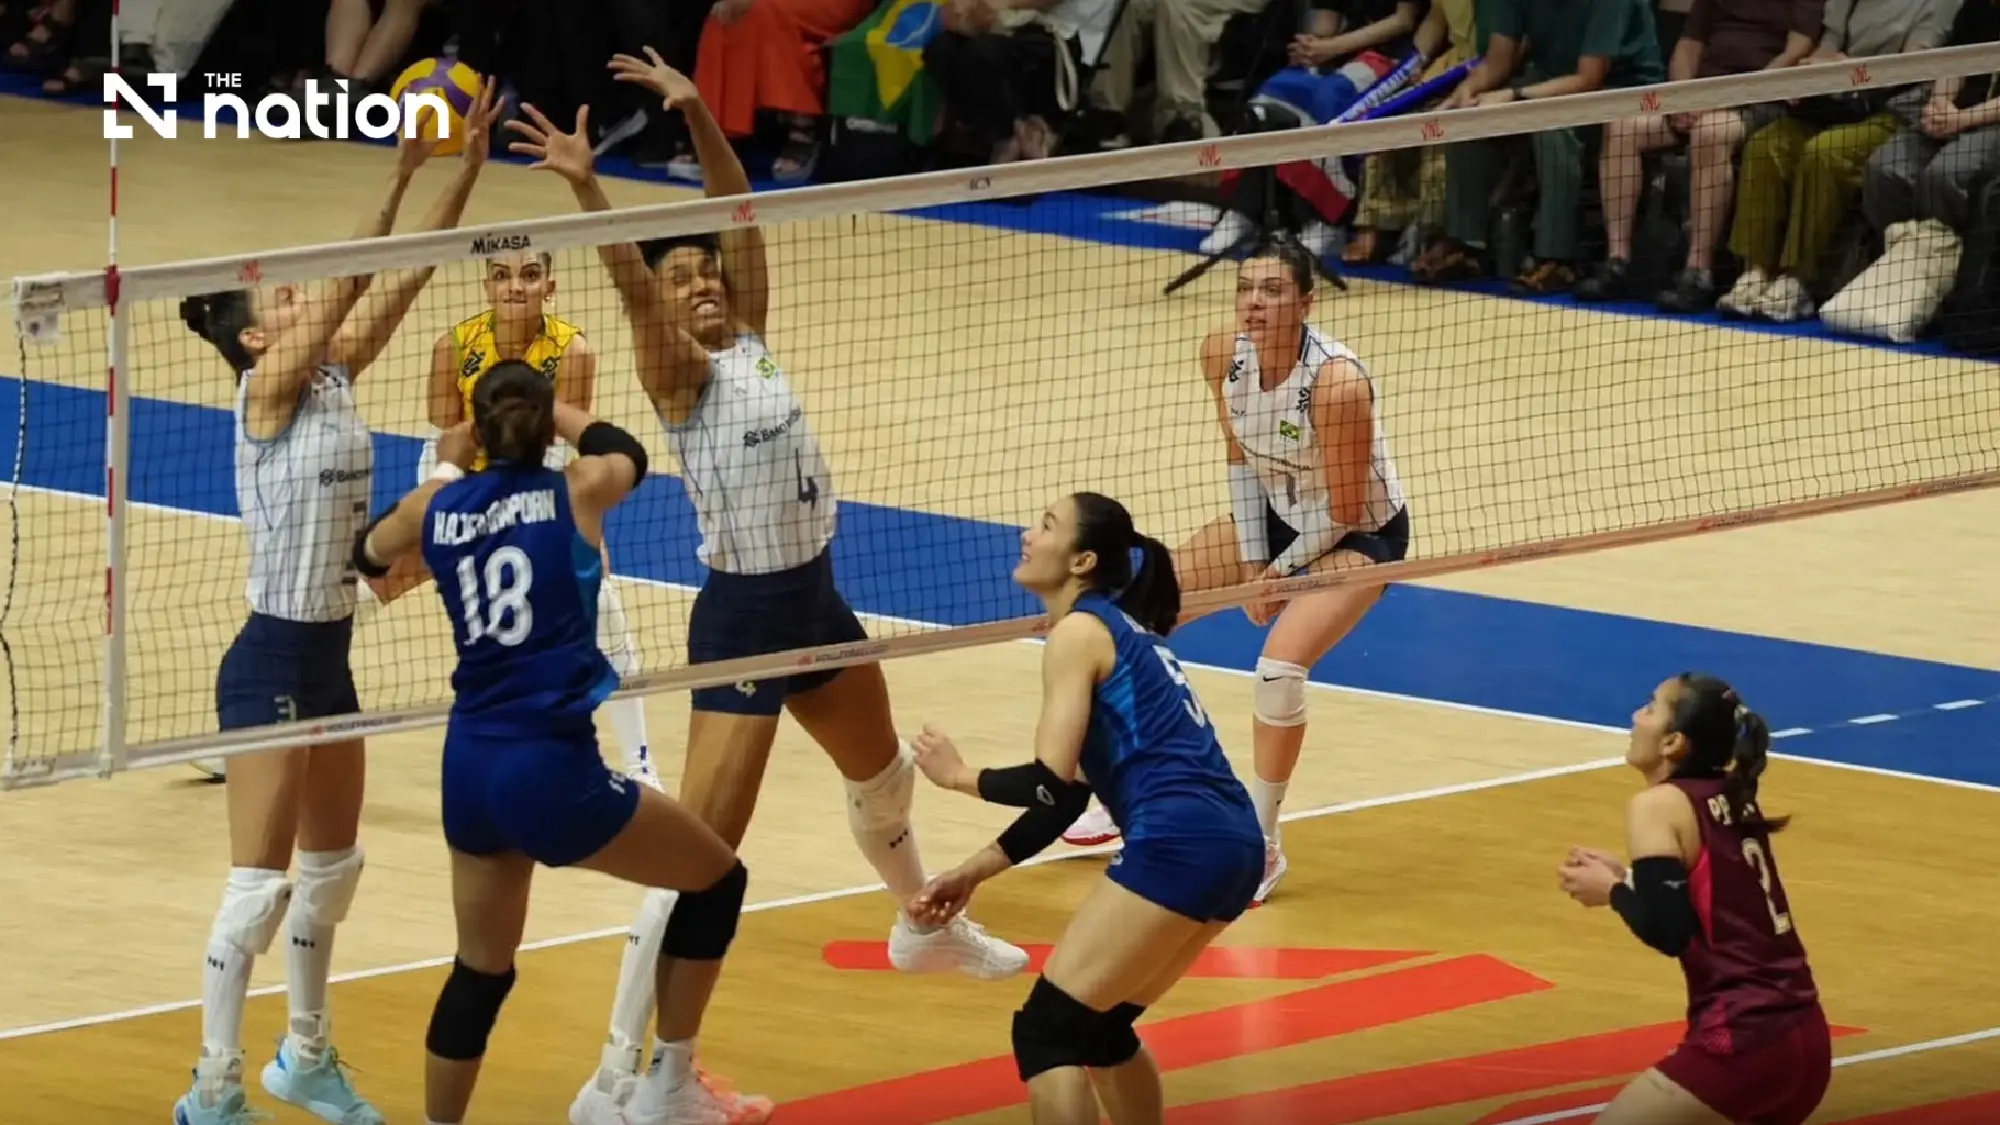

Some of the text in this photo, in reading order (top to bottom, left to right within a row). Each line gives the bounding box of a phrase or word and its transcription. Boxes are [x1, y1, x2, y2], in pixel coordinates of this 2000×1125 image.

[795, 447, 819, 511] 4
[456, 546, 534, 646] 18
[1741, 838, 1791, 935] 2
